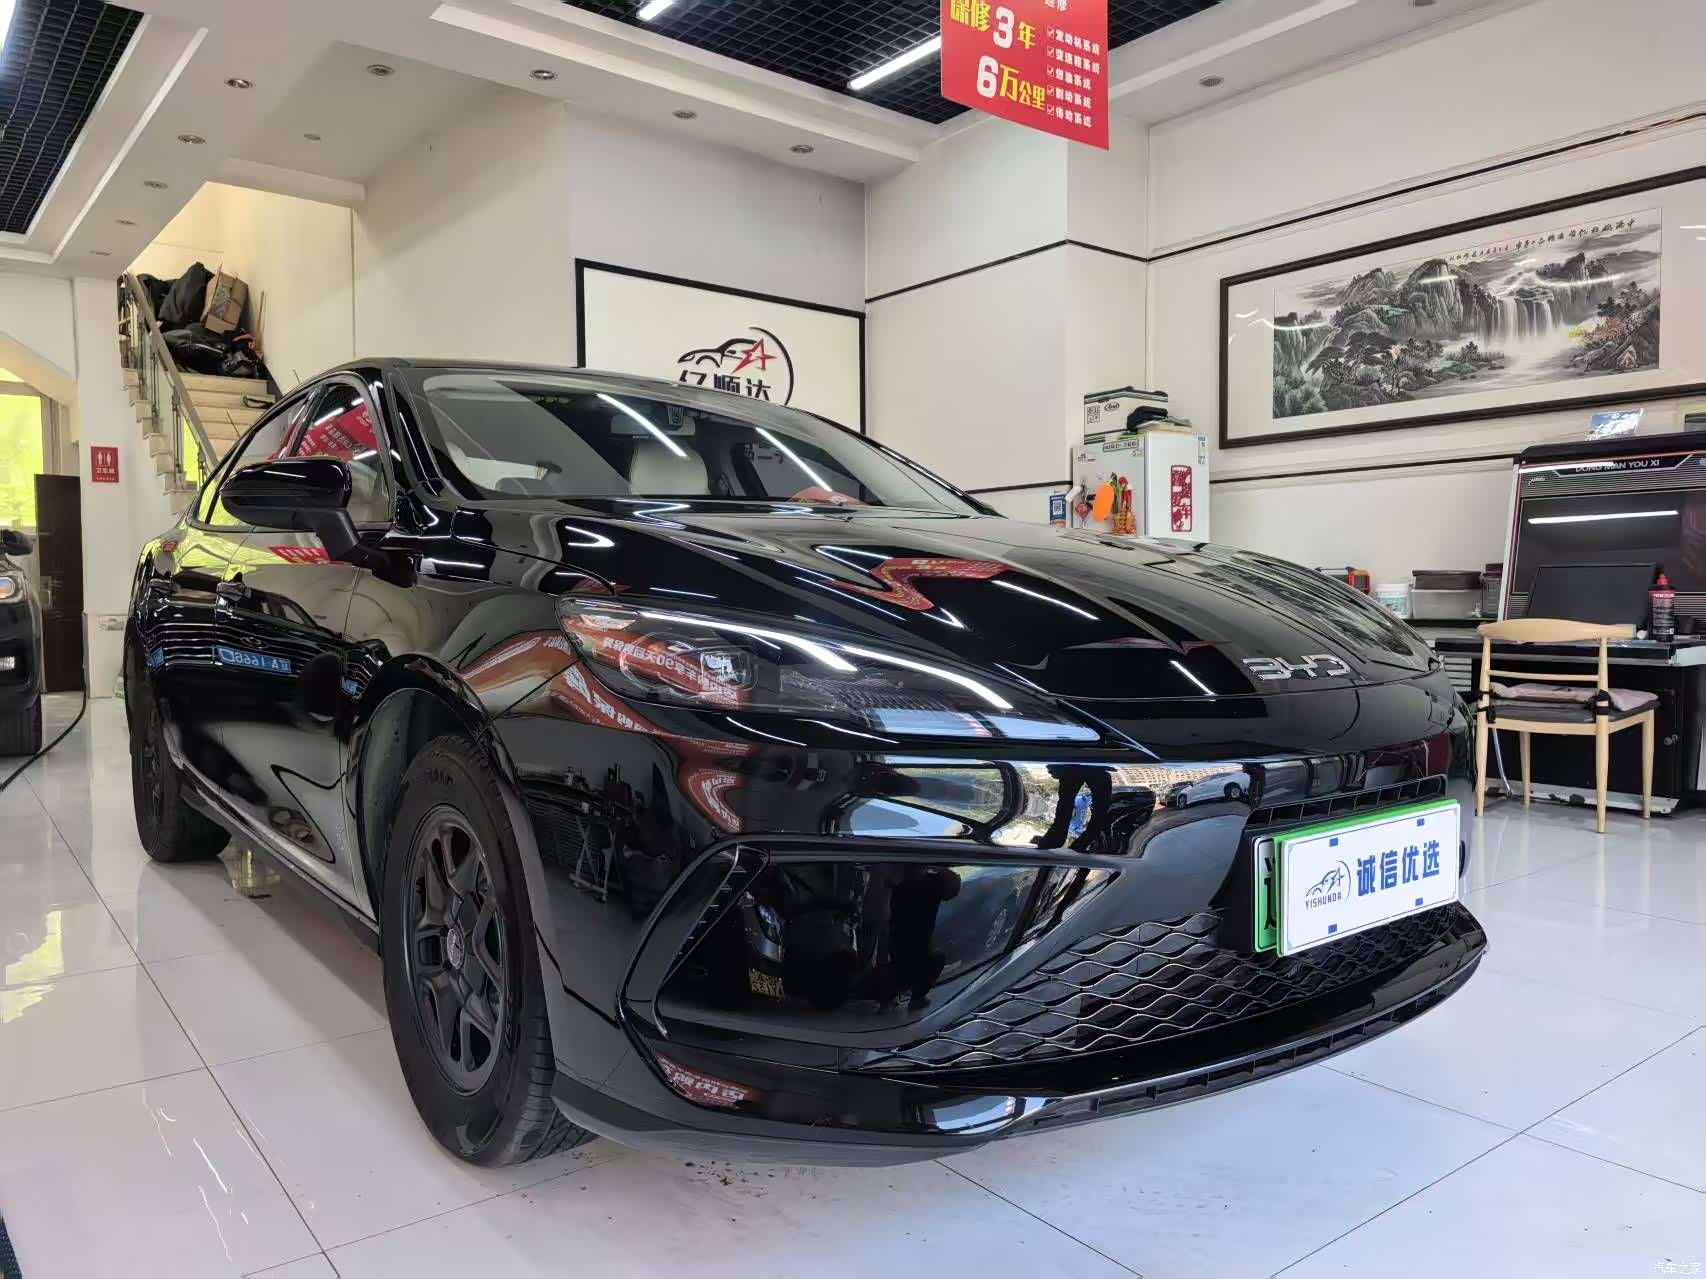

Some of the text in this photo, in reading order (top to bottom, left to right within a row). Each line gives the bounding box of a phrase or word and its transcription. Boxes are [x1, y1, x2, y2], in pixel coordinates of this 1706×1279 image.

[1055, 28, 1100, 55] 发动机系统
[976, 55, 1046, 110] 6万公里
[1627, 460, 1648, 469] YOU
[1650, 459, 1660, 467] XI
[1243, 654, 1351, 680] BYD
[1357, 839, 1440, 897] 诚信优选
[1305, 892, 1342, 910] YISHUNDA
